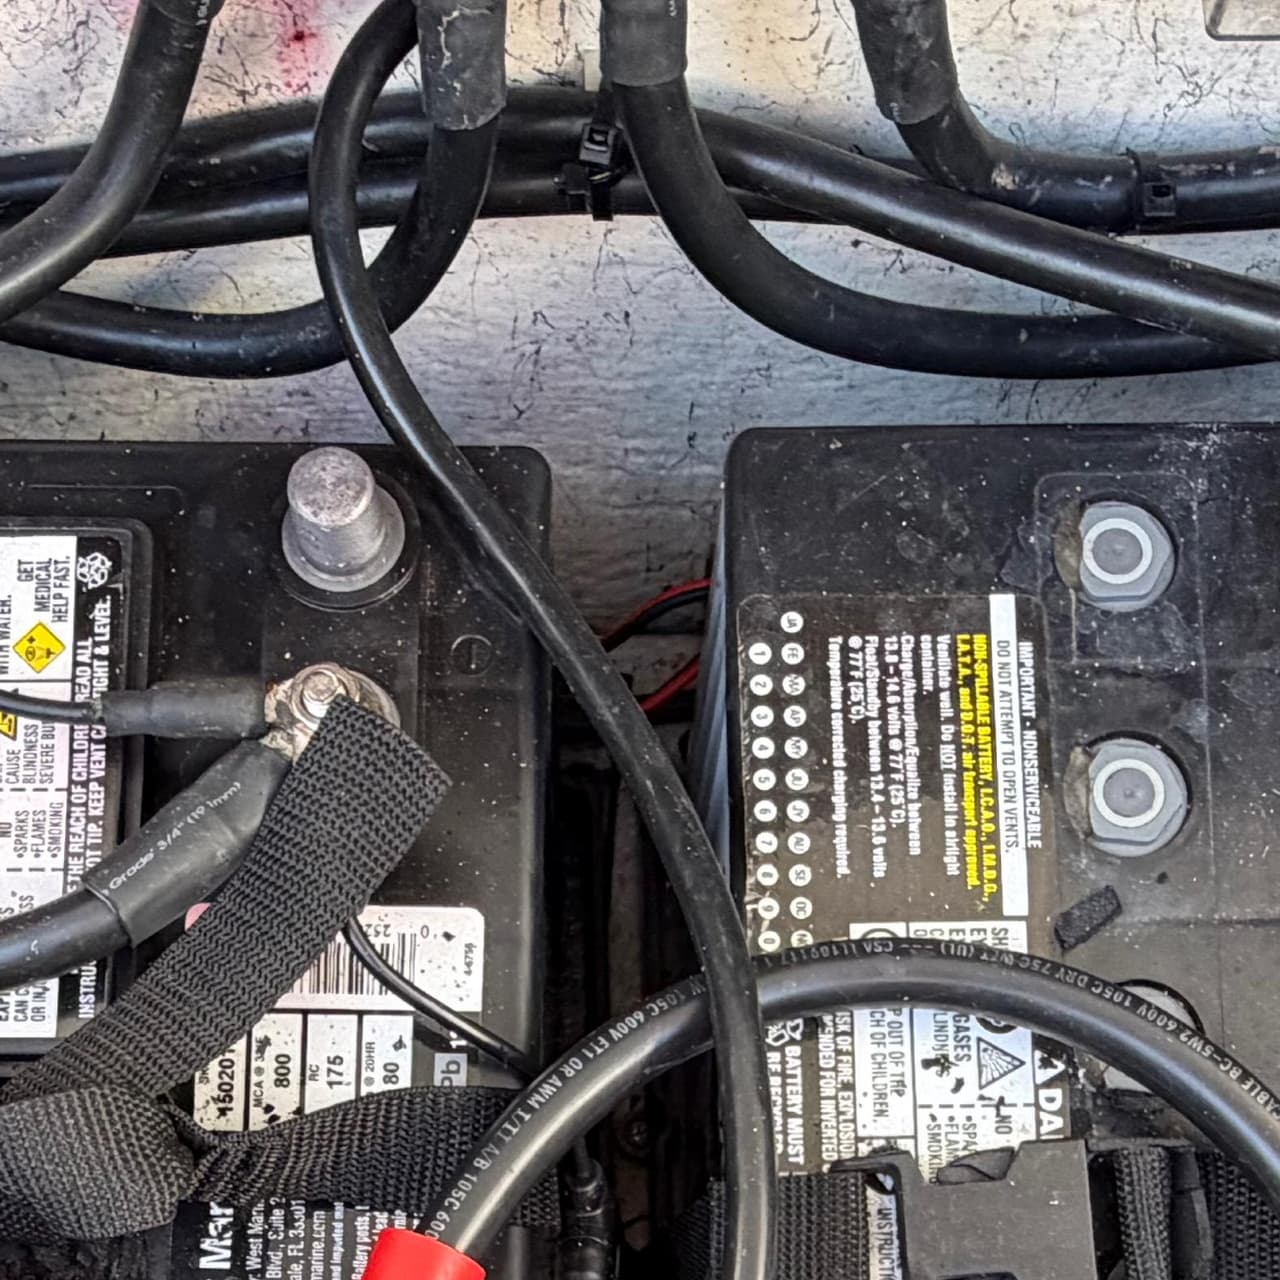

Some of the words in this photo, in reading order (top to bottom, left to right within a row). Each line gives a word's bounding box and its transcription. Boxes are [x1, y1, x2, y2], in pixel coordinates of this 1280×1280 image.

[17, 559, 35, 583] GET
[34, 557, 53, 613] MEDICAL
[53, 555, 71, 588] FAST.
[51, 591, 70, 623] HELP
[93, 594, 112, 643] LEVEL.
[997, 640, 1010, 657] DO
[998, 661, 1012, 686] NOT
[1018, 641, 1036, 718] IMPORTANT
[998, 689, 1014, 745] ATTEMPT
[4, 749, 21, 785] CAUSE
[21, 723, 39, 785] BLINDNESS
[90, 745, 107, 780] VENT
[1001, 751, 1015, 767] TO
[88, 784, 105, 816] KEEP
[1002, 770, 1016, 804] OPEN
[1023, 730, 1042, 849] NONSERVICEABLE
[69, 806, 87, 853] REACH
[1004, 807, 1019, 853] VENTS.
[608, 1010, 645, 1041] 600V
[887, 1021, 902, 1047] OUT
[954, 1014, 970, 1063] GASES
[581, 1036, 610, 1059] FT1
[889, 1051, 902, 1068] OF
[274, 1054, 292, 1089] 800
[309, 1064, 320, 1082] RC
[326, 1055, 344, 1090] 175
[382, 1062, 400, 1085] 80
[559, 1057, 583, 1078] OR
[785, 1045, 803, 1117] BATTERY
[253, 1080, 265, 1108] MCA
[525, 1074, 562, 1110] AWM
[872, 1052, 888, 1122] CHILDREN.
[787, 1119, 805, 1165] MUST
[821, 1101, 840, 1161] INVERTED
[246, 1238, 263, 1270] West
